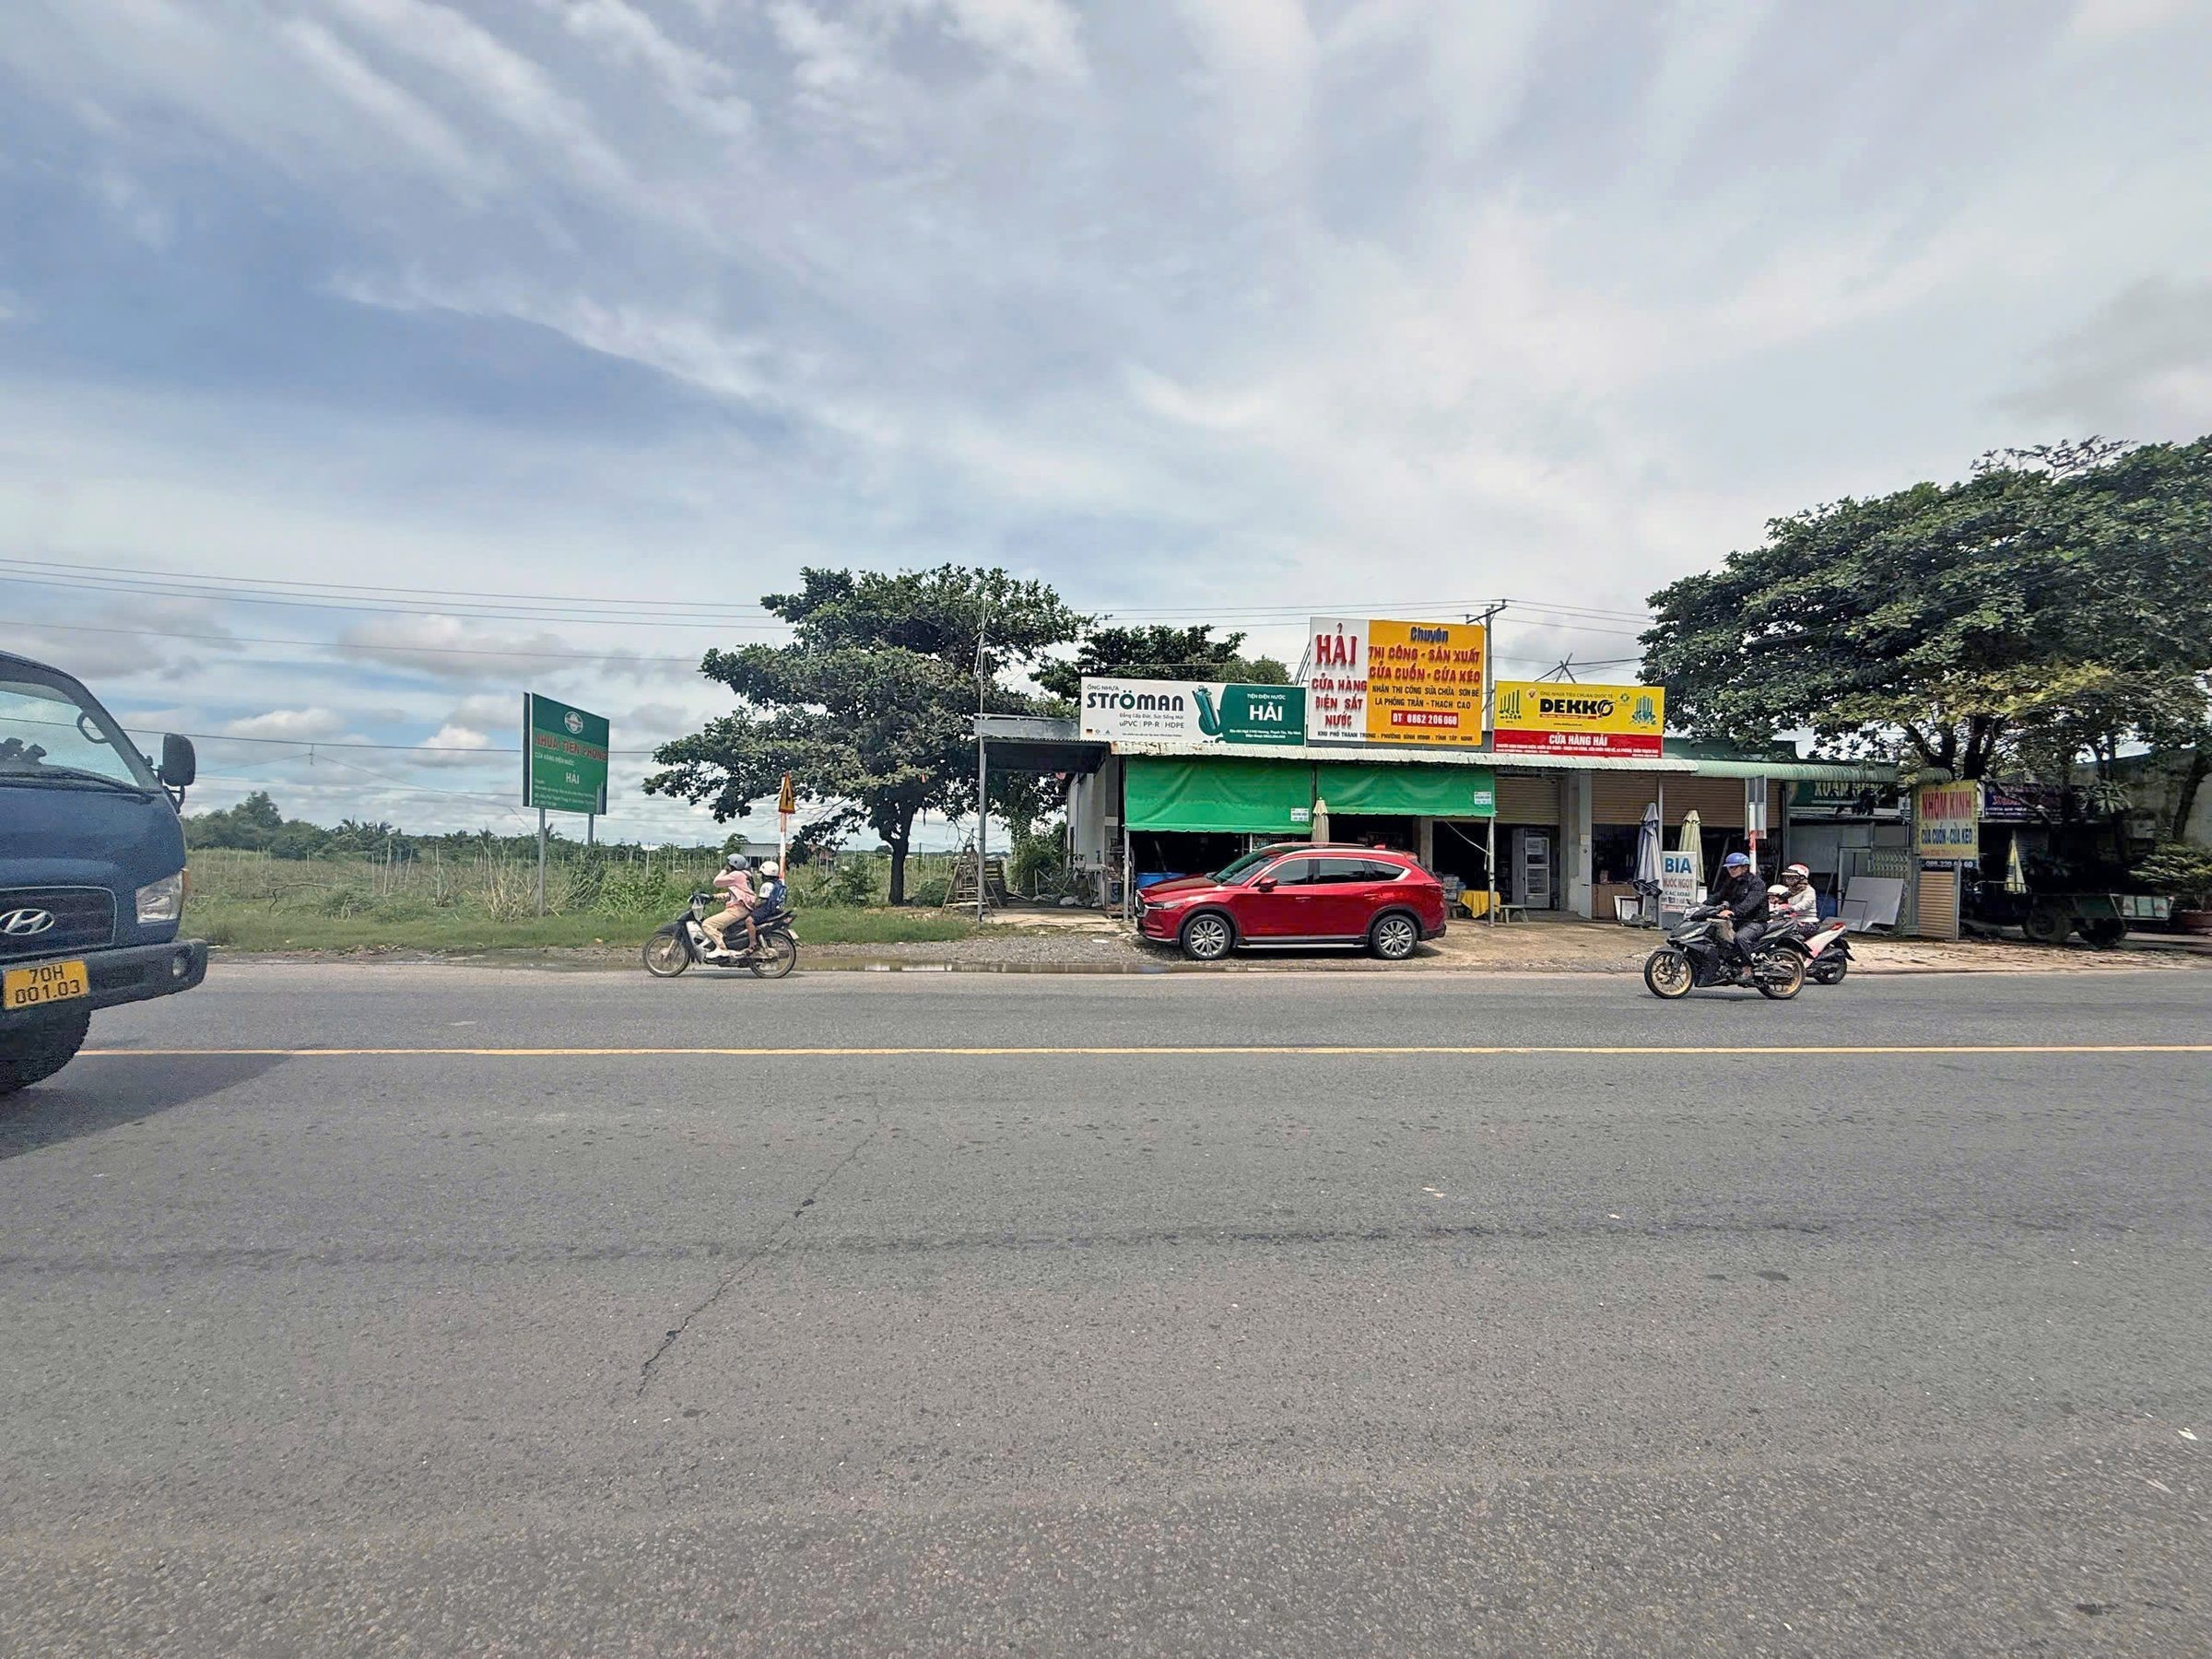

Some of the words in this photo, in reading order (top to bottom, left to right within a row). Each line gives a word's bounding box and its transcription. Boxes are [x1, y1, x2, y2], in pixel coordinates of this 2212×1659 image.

[1410, 627, 1448, 642] Chuyên
[1316, 622, 1357, 665] HẢI
[1369, 646, 1384, 658] THI
[1389, 644, 1418, 660] CÔNG
[1429, 646, 1451, 662] SẢN
[1453, 648, 1480, 663] XUẤT
[1370, 661, 1391, 678] CỬA
[1395, 663, 1425, 679] CUỐN
[1434, 665, 1456, 682] CỬA
[1459, 668, 1480, 682] KÉO
[1312, 673, 1335, 689] CỬA
[1338, 676, 1367, 691] HÀNG
[1393, 686, 1403, 694] THI
[1405, 685, 1421, 695] CÔNG
[1316, 694, 1337, 710] ĐIỆN
[1345, 693, 1363, 710] SẮT
[1457, 700, 1471, 709] CAO
[1539, 698, 1615, 718] DEKKO
[1250, 701, 1283, 722] HẢI
[1325, 711, 1352, 726] NƯỚC
[1407, 713, 1427, 724] 0862
[1549, 732, 1566, 745] CỬA
[1569, 733, 1591, 746] HÀNG
[1594, 733, 1607, 746] HẢI
[566, 770, 580, 784] HẢI
[1665, 858, 1692, 874] BIA
[29, 965, 65, 984] 70H
[15, 979, 80, 1005] 001.03
